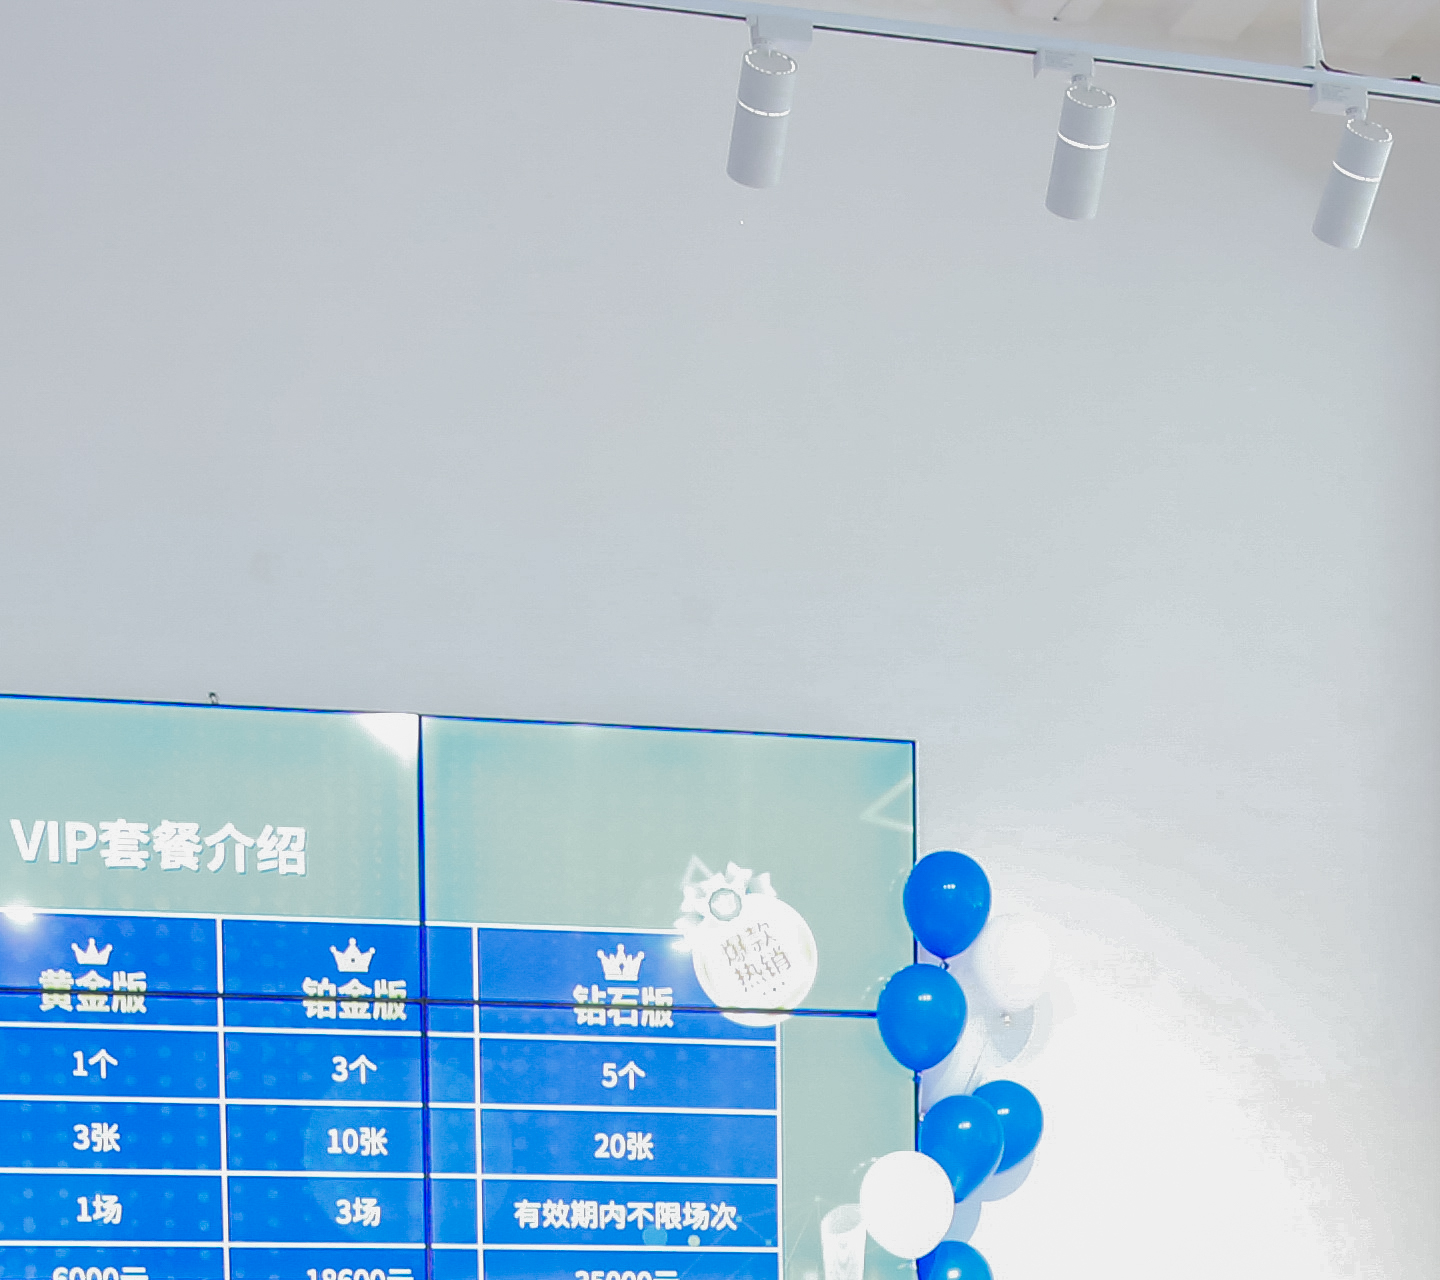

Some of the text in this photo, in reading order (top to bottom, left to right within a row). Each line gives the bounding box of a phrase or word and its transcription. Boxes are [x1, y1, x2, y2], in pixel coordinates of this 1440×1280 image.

[9, 818, 306, 877] VIP套餐介绍
[39, 969, 148, 1014] 黄金版
[302, 977, 407, 1021] 铂金版
[573, 984, 674, 1028] 钻石版
[73, 1048, 118, 1079] 1个
[331, 1054, 378, 1085] 3个
[601, 1060, 646, 1091] 5个
[73, 1123, 121, 1153] 3张
[326, 1127, 389, 1157] 10张
[593, 1131, 655, 1161] 20张
[76, 1194, 123, 1225] 1场
[335, 1197, 381, 1228] 3场
[514, 1200, 738, 1232] 有效期内不限场次
